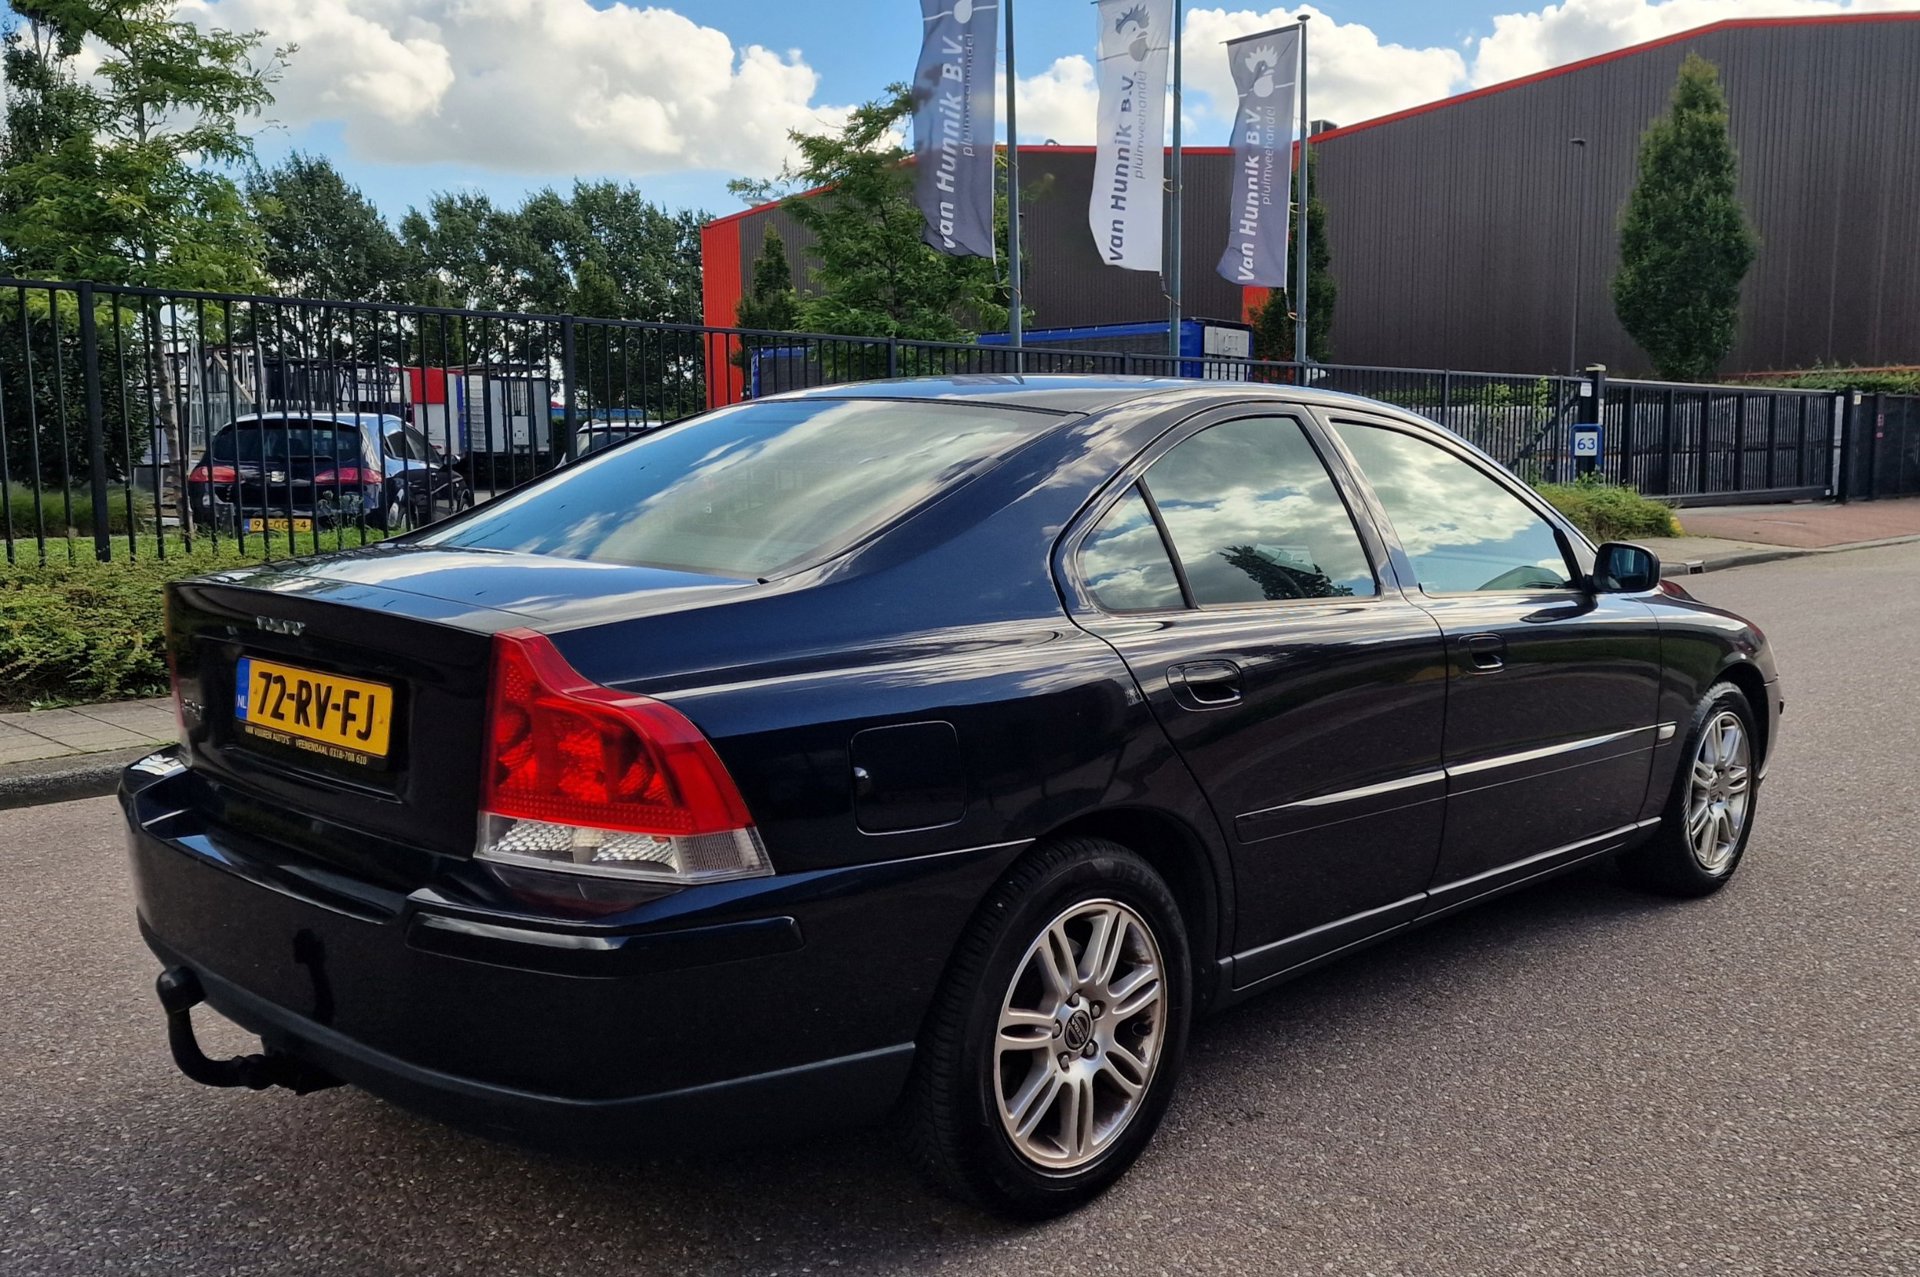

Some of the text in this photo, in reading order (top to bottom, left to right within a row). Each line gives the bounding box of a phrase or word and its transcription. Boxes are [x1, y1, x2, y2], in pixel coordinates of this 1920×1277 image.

[942, 35, 963, 82] B.V.
[936, 92, 961, 193] Hunnik
[1109, 71, 1137, 261] Van Hunnik B.V.
[1133, 70, 1147, 180] pluimveehandel
[1261, 105, 1275, 206] pluimveehandel
[1237, 106, 1261, 281] Van Hunnik B.V.
[1577, 437, 1596, 450] 63
[237, 694, 247, 710] NL
[257, 671, 375, 742] 72-RV-FJ
